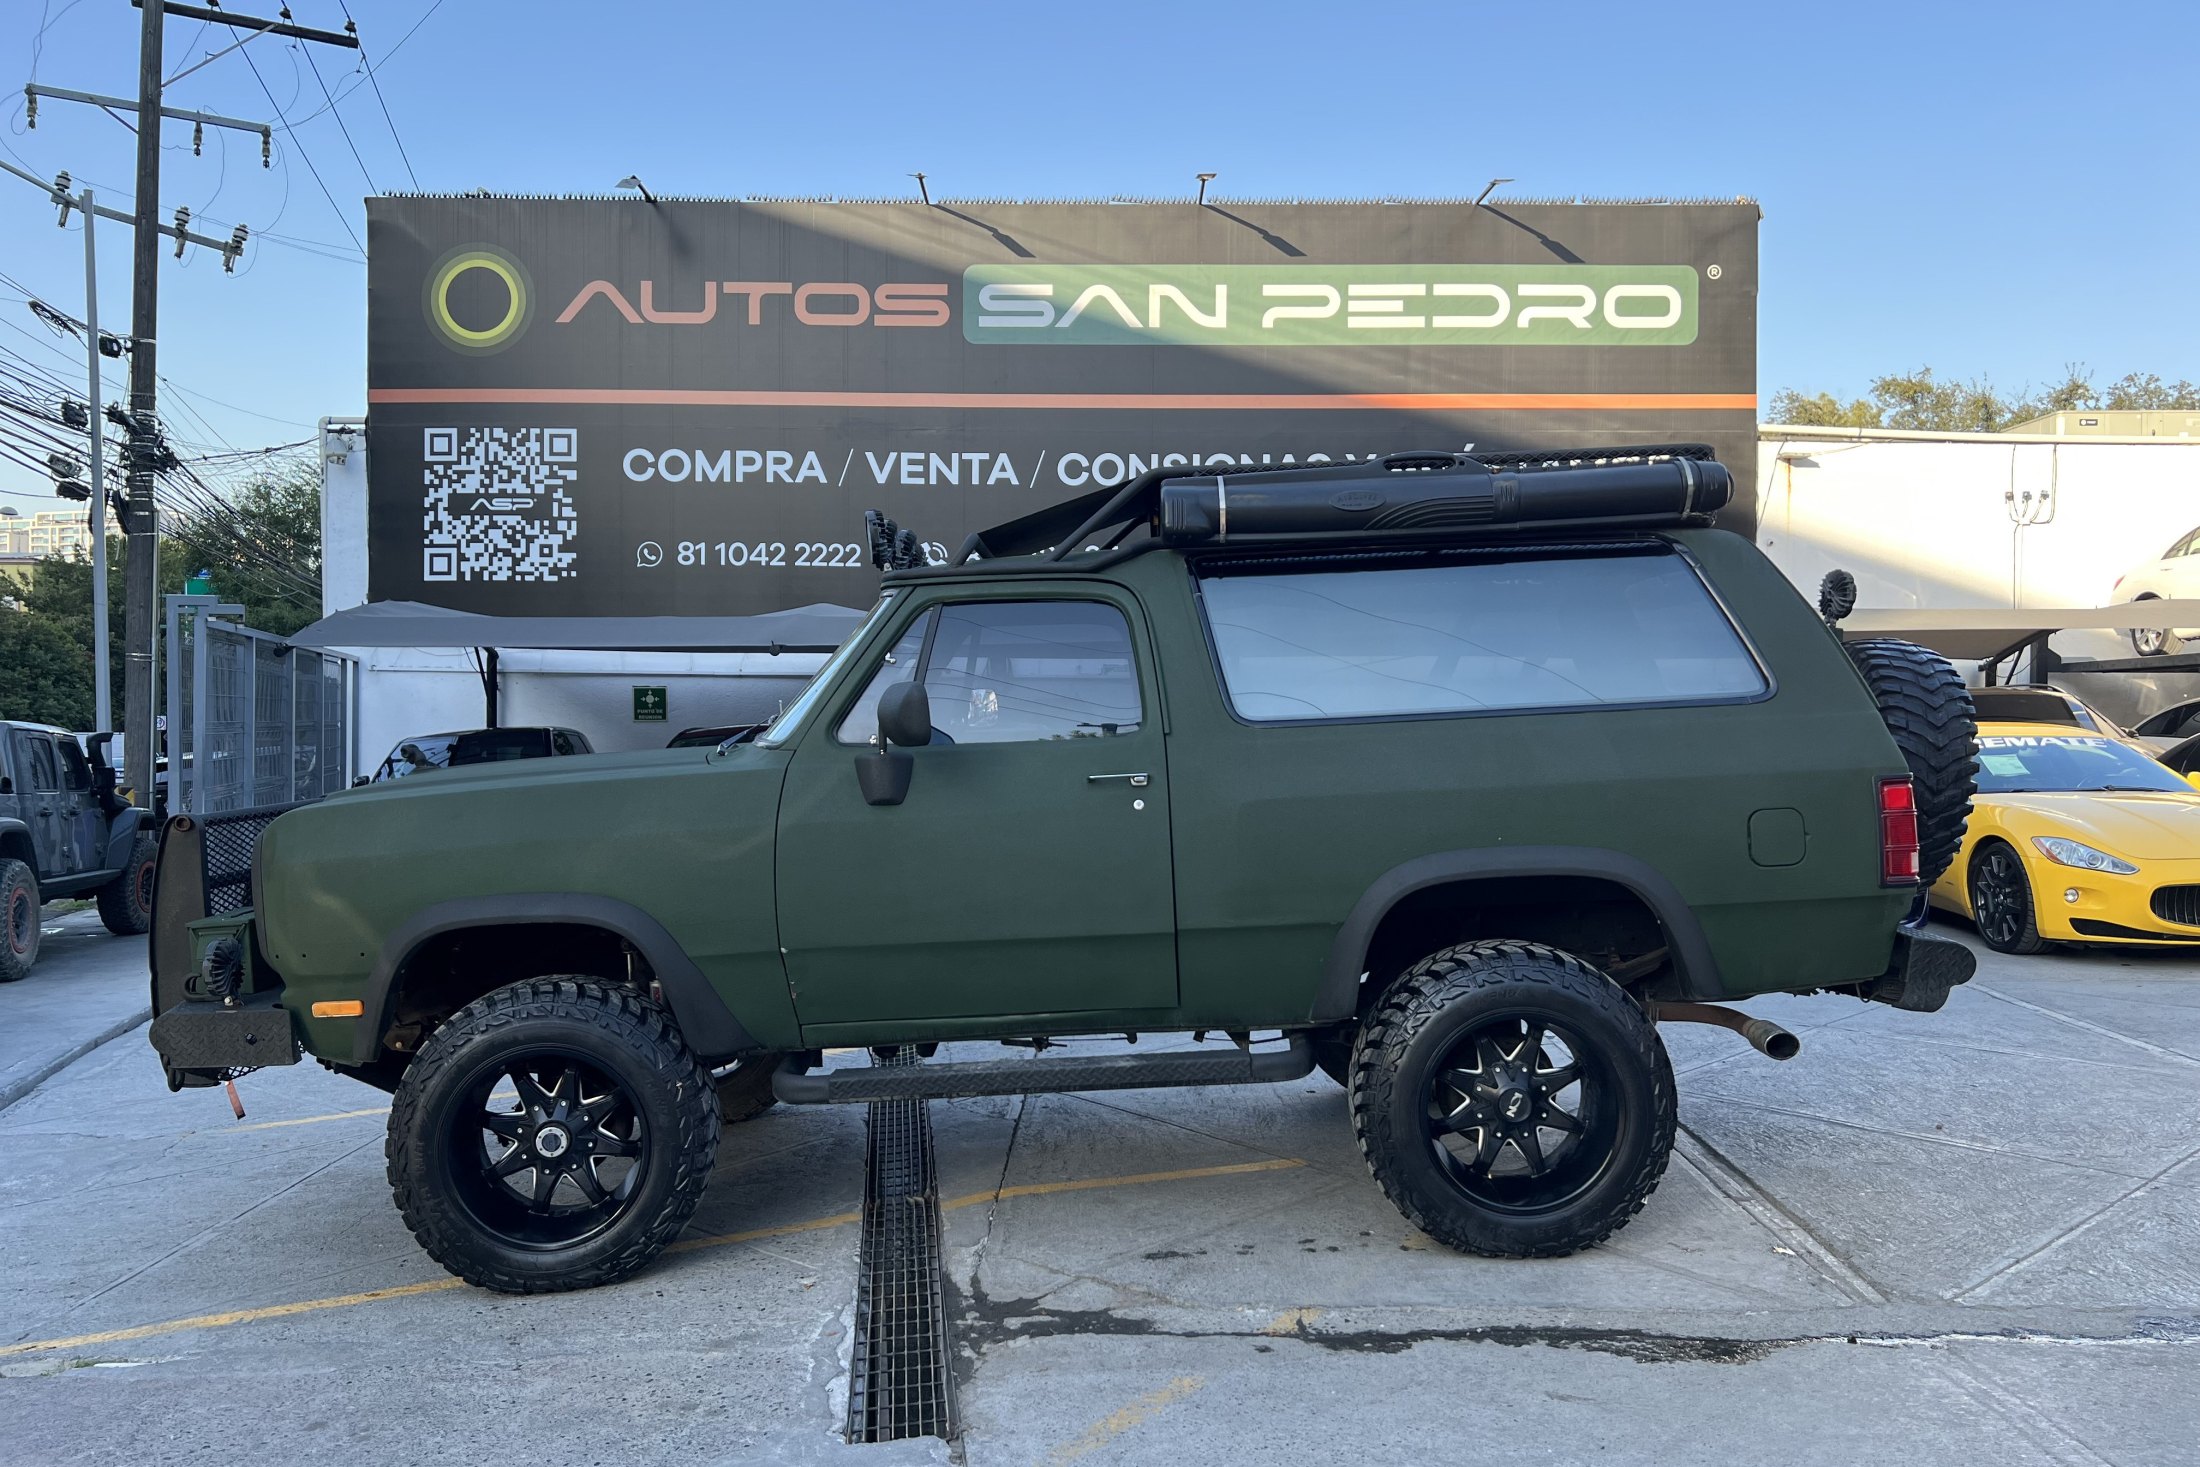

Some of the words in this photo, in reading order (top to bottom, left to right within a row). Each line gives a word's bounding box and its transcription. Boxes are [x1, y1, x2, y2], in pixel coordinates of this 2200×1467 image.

[555, 280, 951, 328] AUTOS
[977, 283, 1228, 329] SAN
[1262, 283, 1682, 329] PEDRO
[622, 448, 828, 484] COMPRA
[864, 450, 1020, 486] VENTA
[677, 541, 706, 566] 81
[714, 541, 786, 567] 1042
[794, 542, 862, 567] 2222
